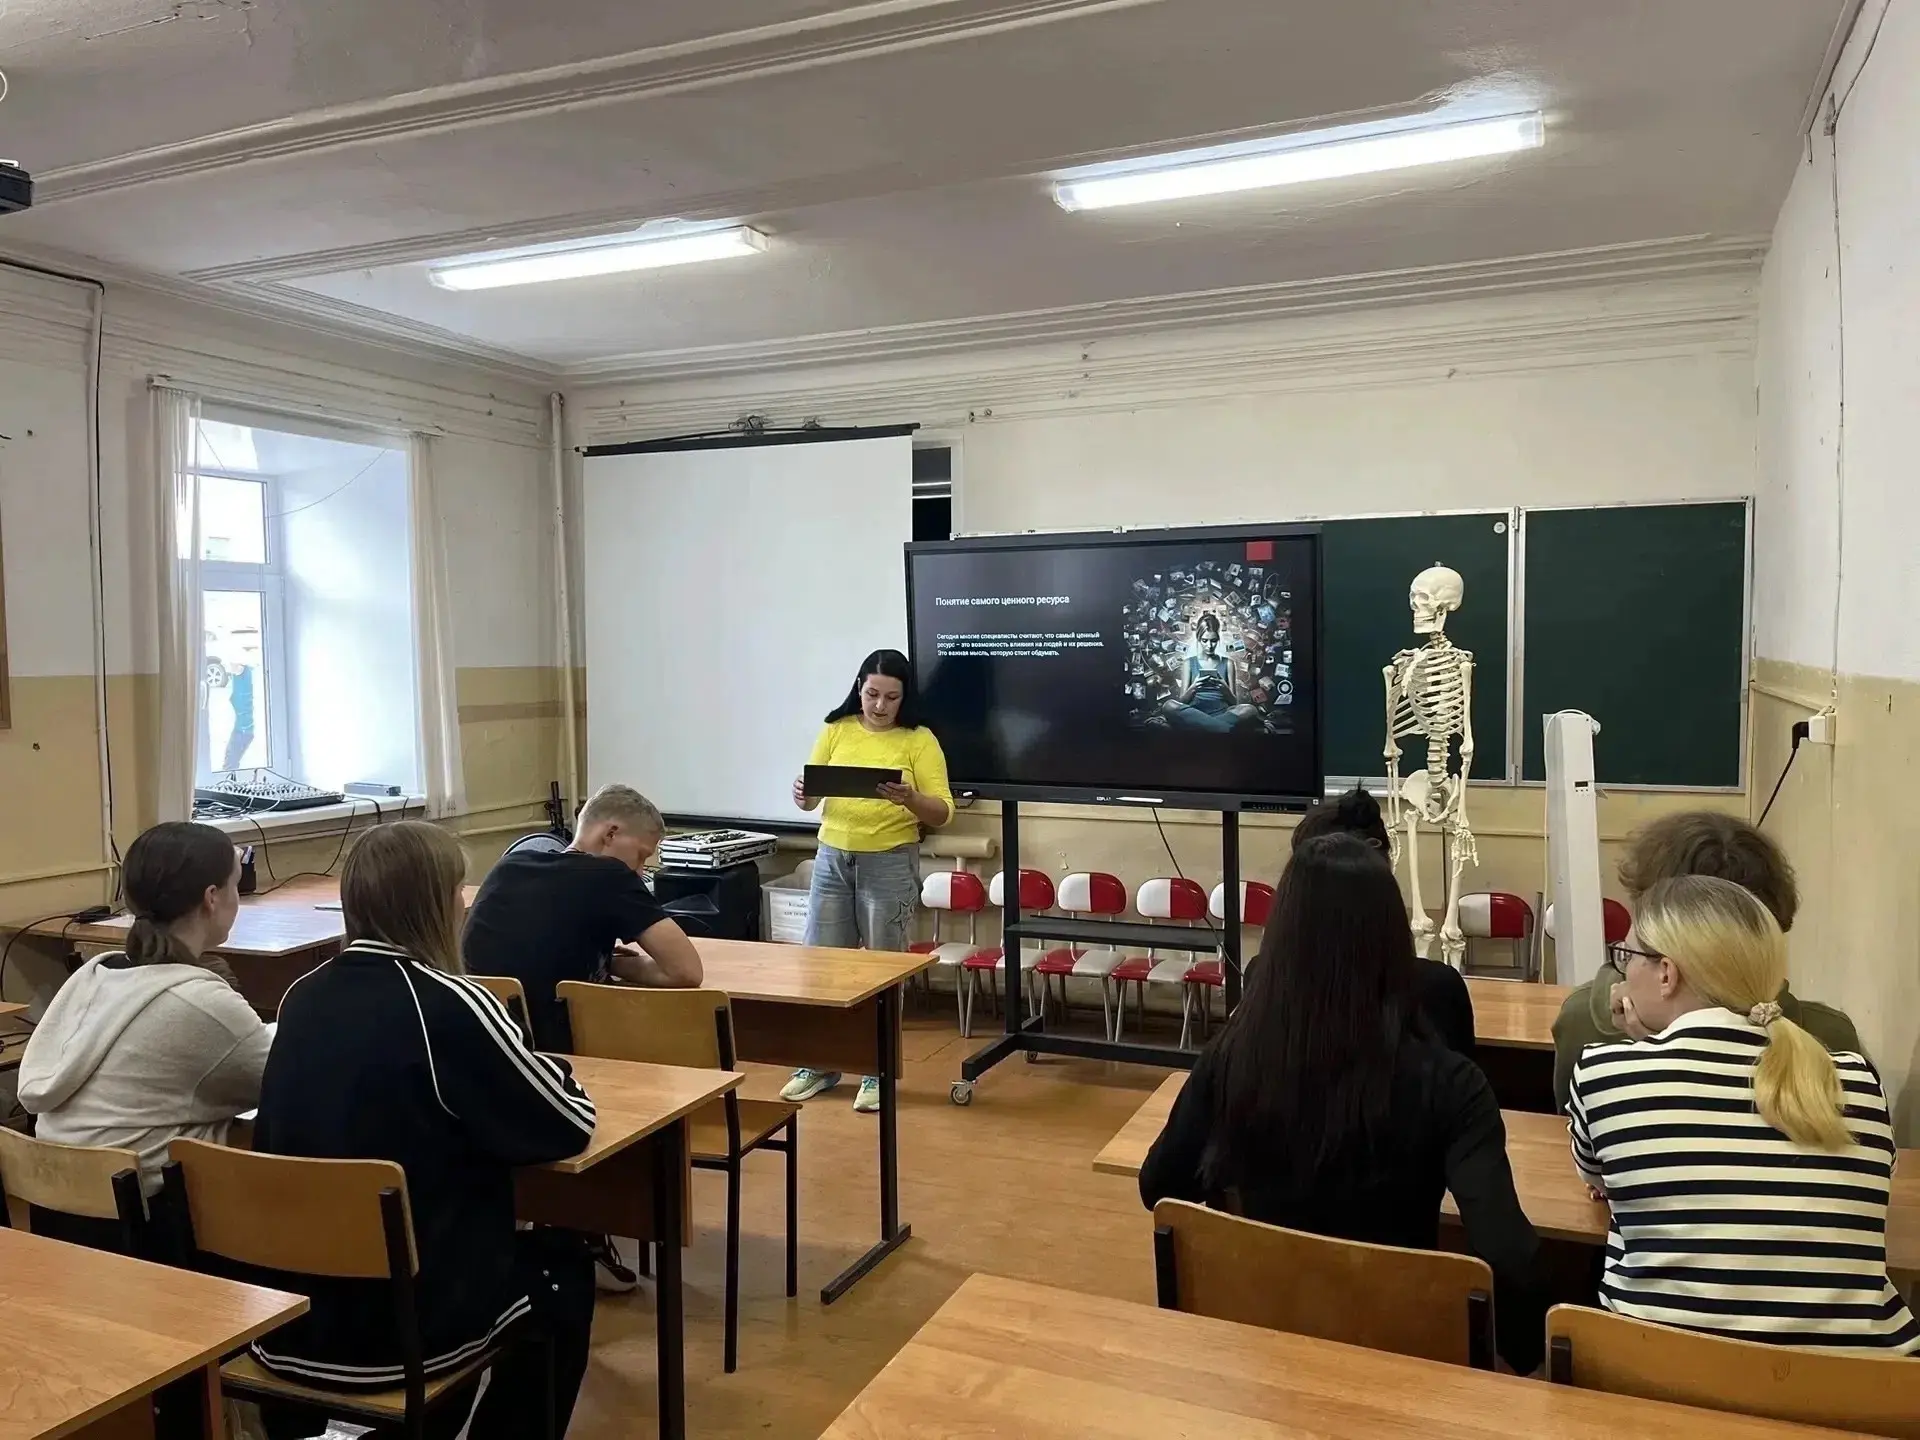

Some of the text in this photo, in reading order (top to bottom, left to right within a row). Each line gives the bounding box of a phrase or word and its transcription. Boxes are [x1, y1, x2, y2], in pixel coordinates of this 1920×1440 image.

[935, 596, 1070, 606] Понятие самого ценного ресурса
[1076, 631, 1100, 639] ценный
[1043, 640, 1062, 648] людей
